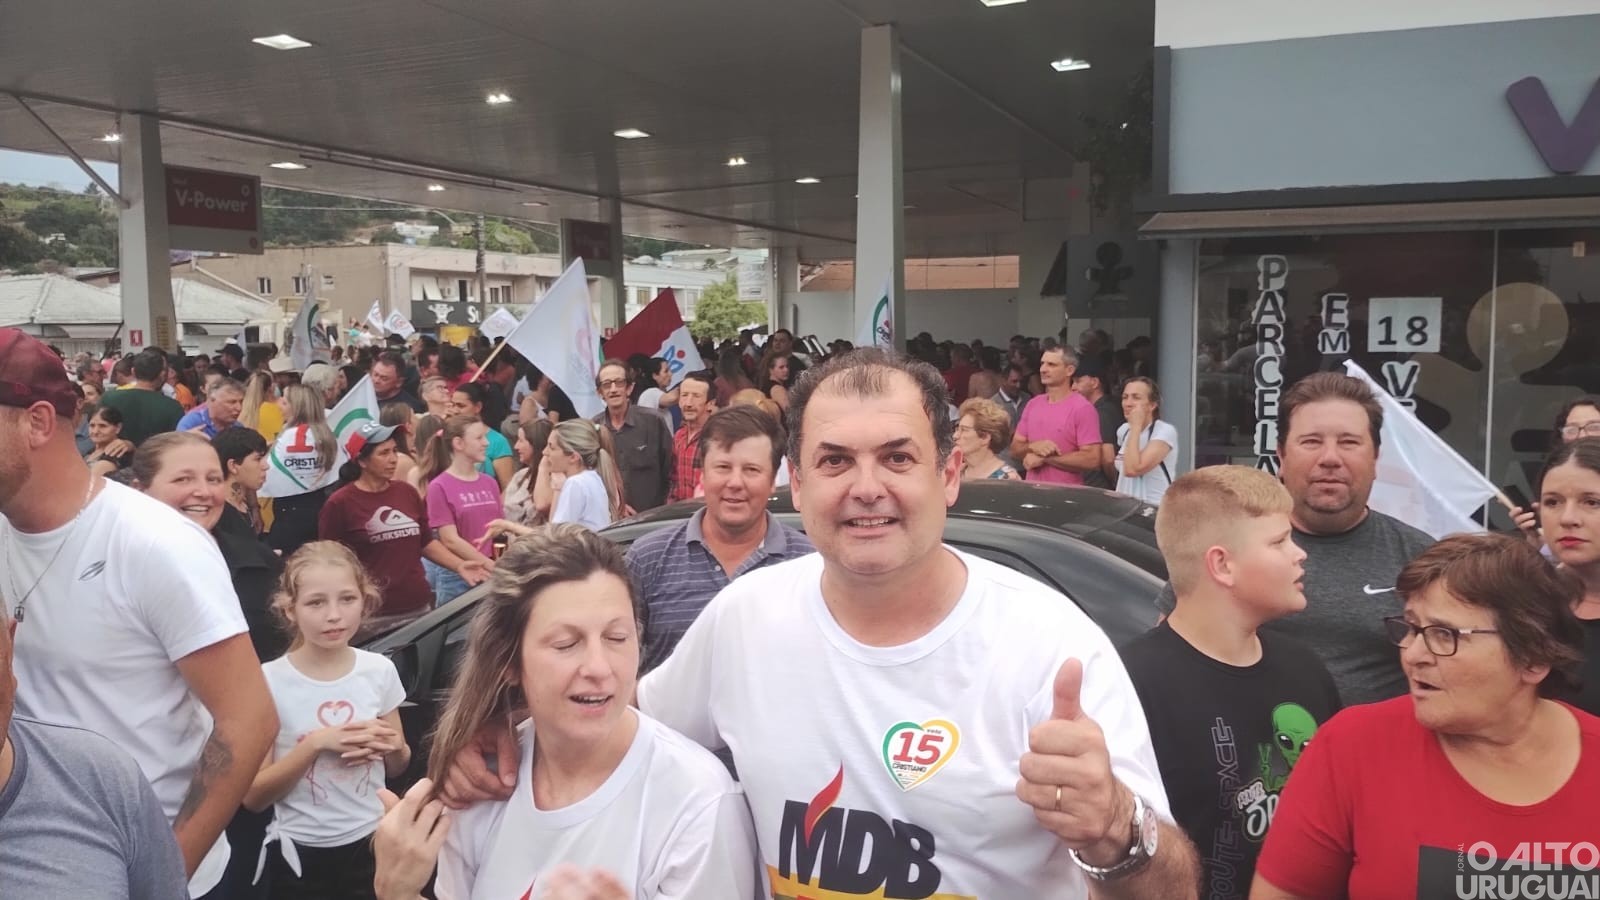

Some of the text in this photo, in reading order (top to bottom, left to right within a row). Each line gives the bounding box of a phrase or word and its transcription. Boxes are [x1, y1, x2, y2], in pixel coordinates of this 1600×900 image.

[175, 189, 248, 213] V-Power
[1320, 294, 1348, 353] EM
[1377, 316, 1429, 346] 18
[369, 527, 420, 543] QUIKSILVER
[893, 732, 944, 765] 15
[892, 762, 927, 773] CRISTIANO
[779, 799, 942, 899] MDB
